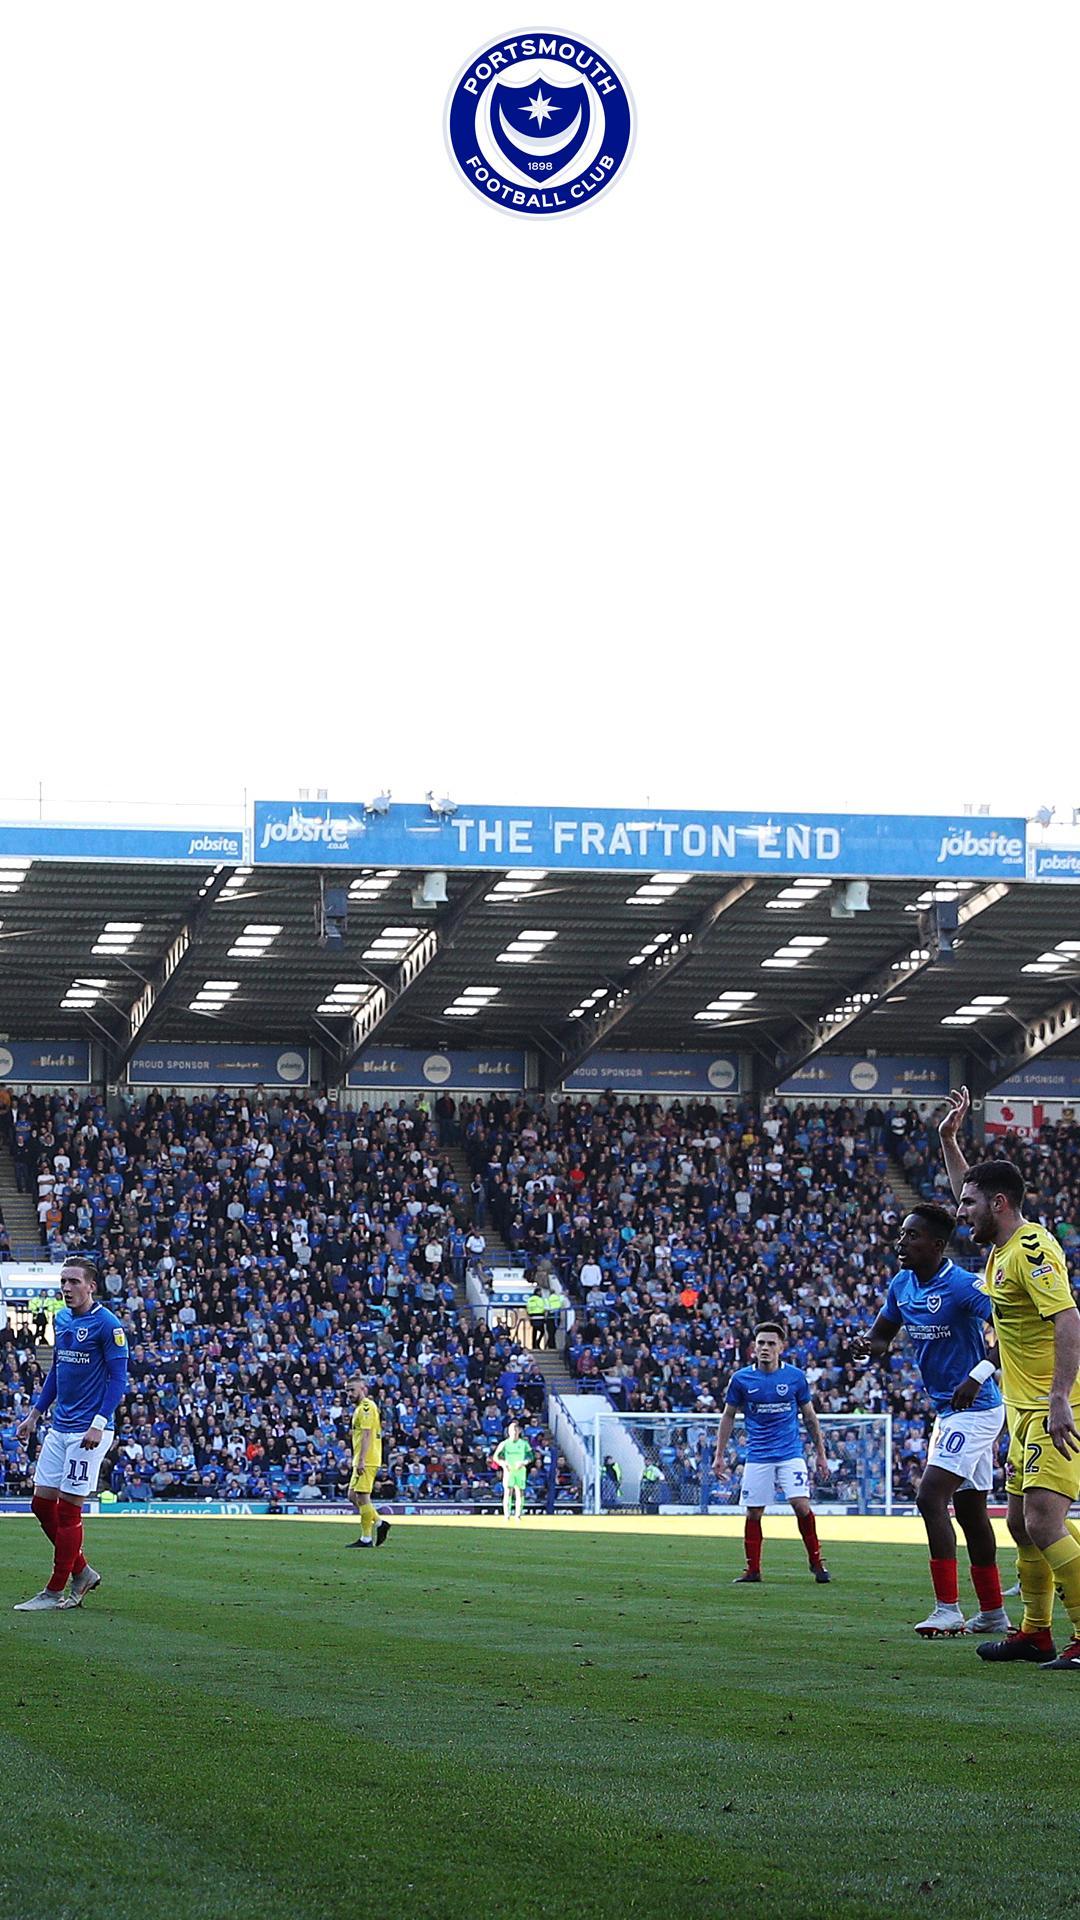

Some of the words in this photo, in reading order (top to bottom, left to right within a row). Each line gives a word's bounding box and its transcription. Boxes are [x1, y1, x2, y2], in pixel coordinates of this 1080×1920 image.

[188, 836, 238, 855] jobsite
[260, 815, 348, 849] jobsite
[451, 819, 533, 853] THE
[554, 821, 736, 858] FRATTON
[757, 824, 841, 860] END
[937, 830, 1023, 863] jobsite
[132, 1060, 164, 1069] PROUD
[166, 1060, 210, 1070] SPONSOR
[600, 1068, 643, 1077] SPONSOR
[937, 1427, 965, 1454] 10
[67, 1459, 88, 1481] 11
[1025, 1443, 1042, 1473] 2
